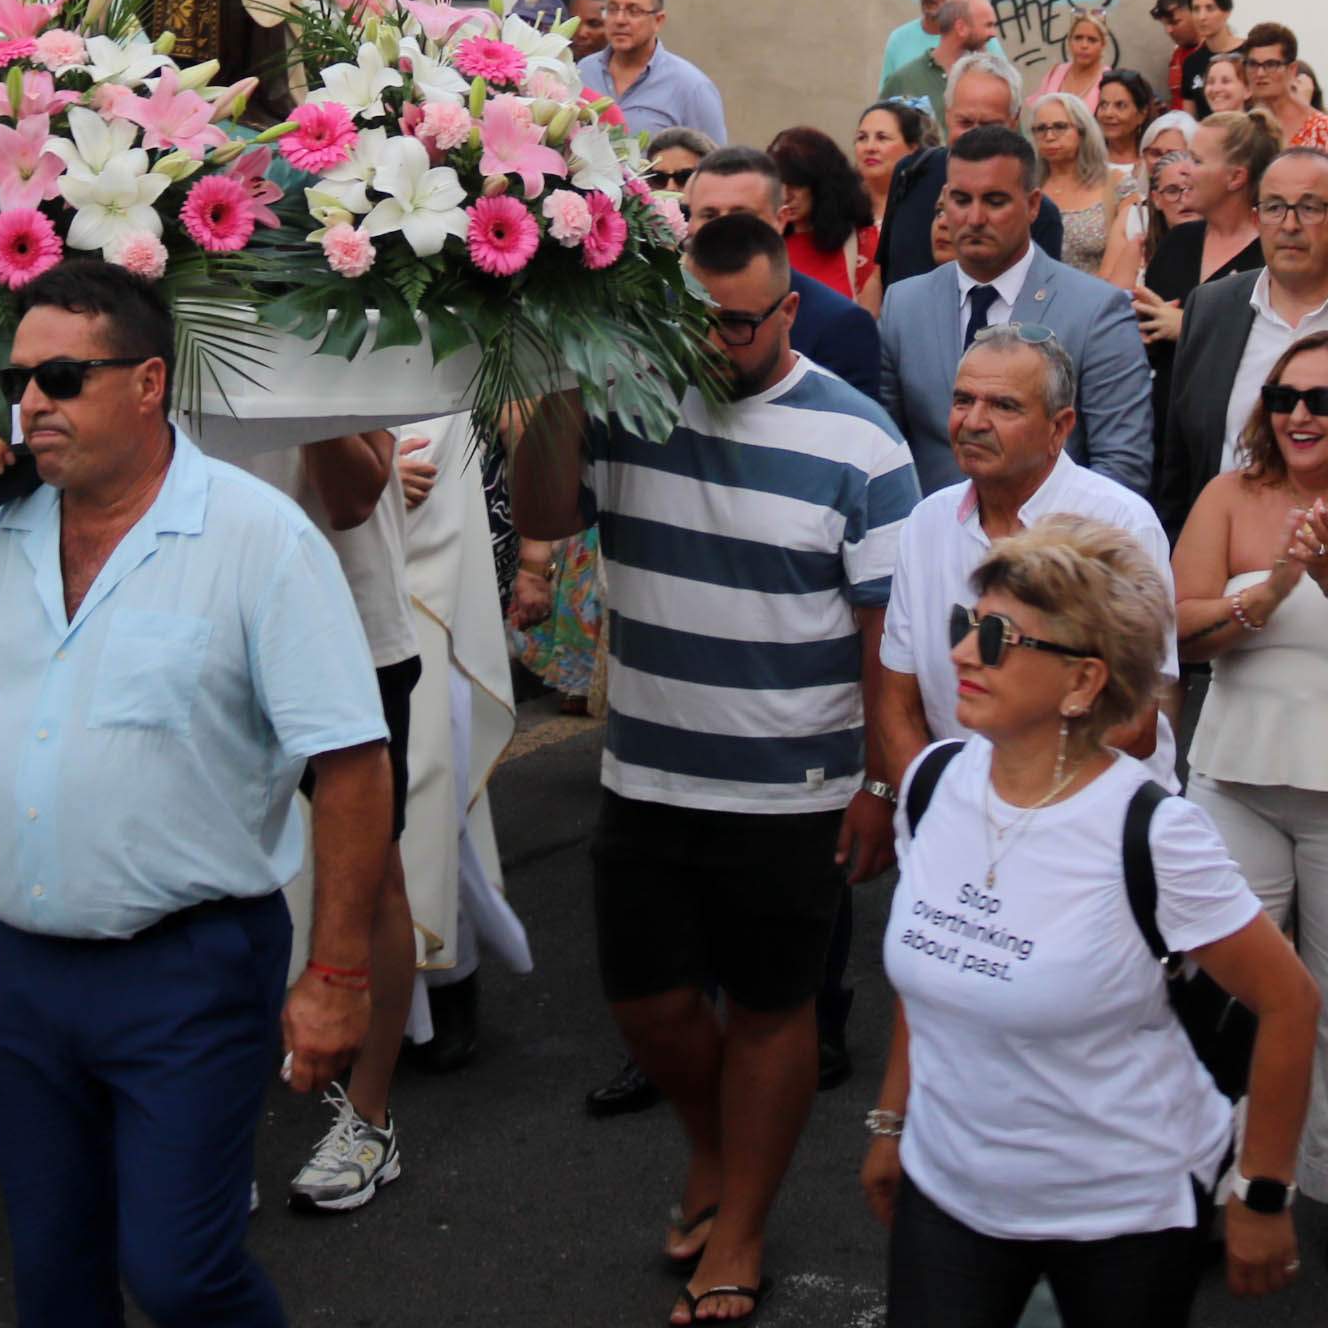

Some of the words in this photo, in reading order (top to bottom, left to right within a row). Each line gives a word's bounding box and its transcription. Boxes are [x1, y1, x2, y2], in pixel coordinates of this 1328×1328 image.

[956, 882, 1002, 917] Stop
[900, 929, 959, 964] about
[959, 952, 1014, 982] past.
[912, 900, 1035, 960] overthinking
